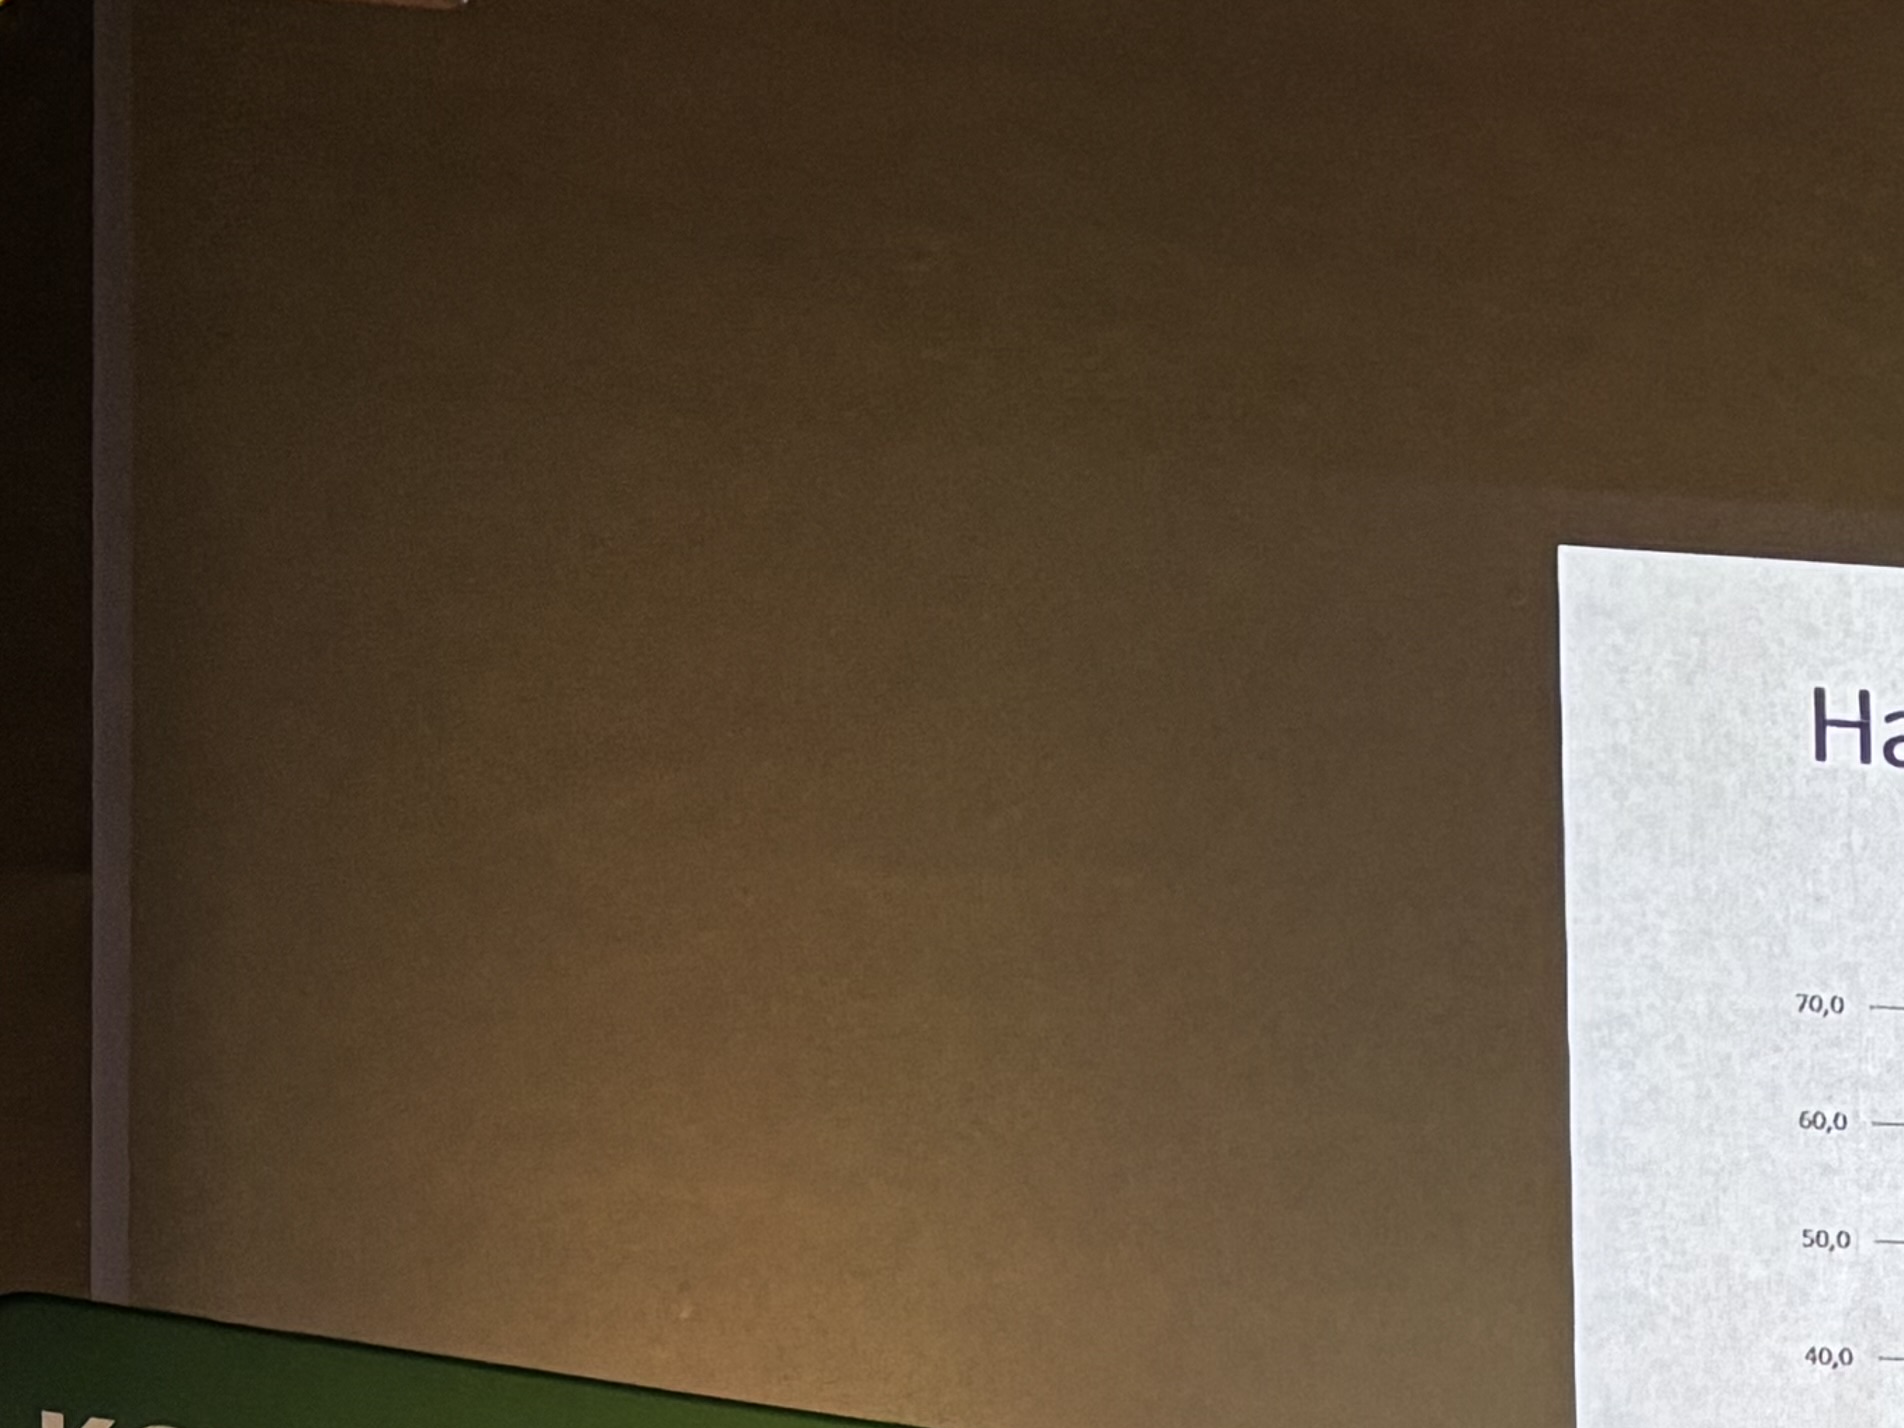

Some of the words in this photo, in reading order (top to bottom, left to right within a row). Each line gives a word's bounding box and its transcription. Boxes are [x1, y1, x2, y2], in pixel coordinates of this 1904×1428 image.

[1795, 994, 1845, 1018] 70,0
[1798, 1111, 1848, 1135] 60,0
[1801, 1229, 1851, 1253] 50,0
[1804, 1345, 1854, 1370] 40,0
